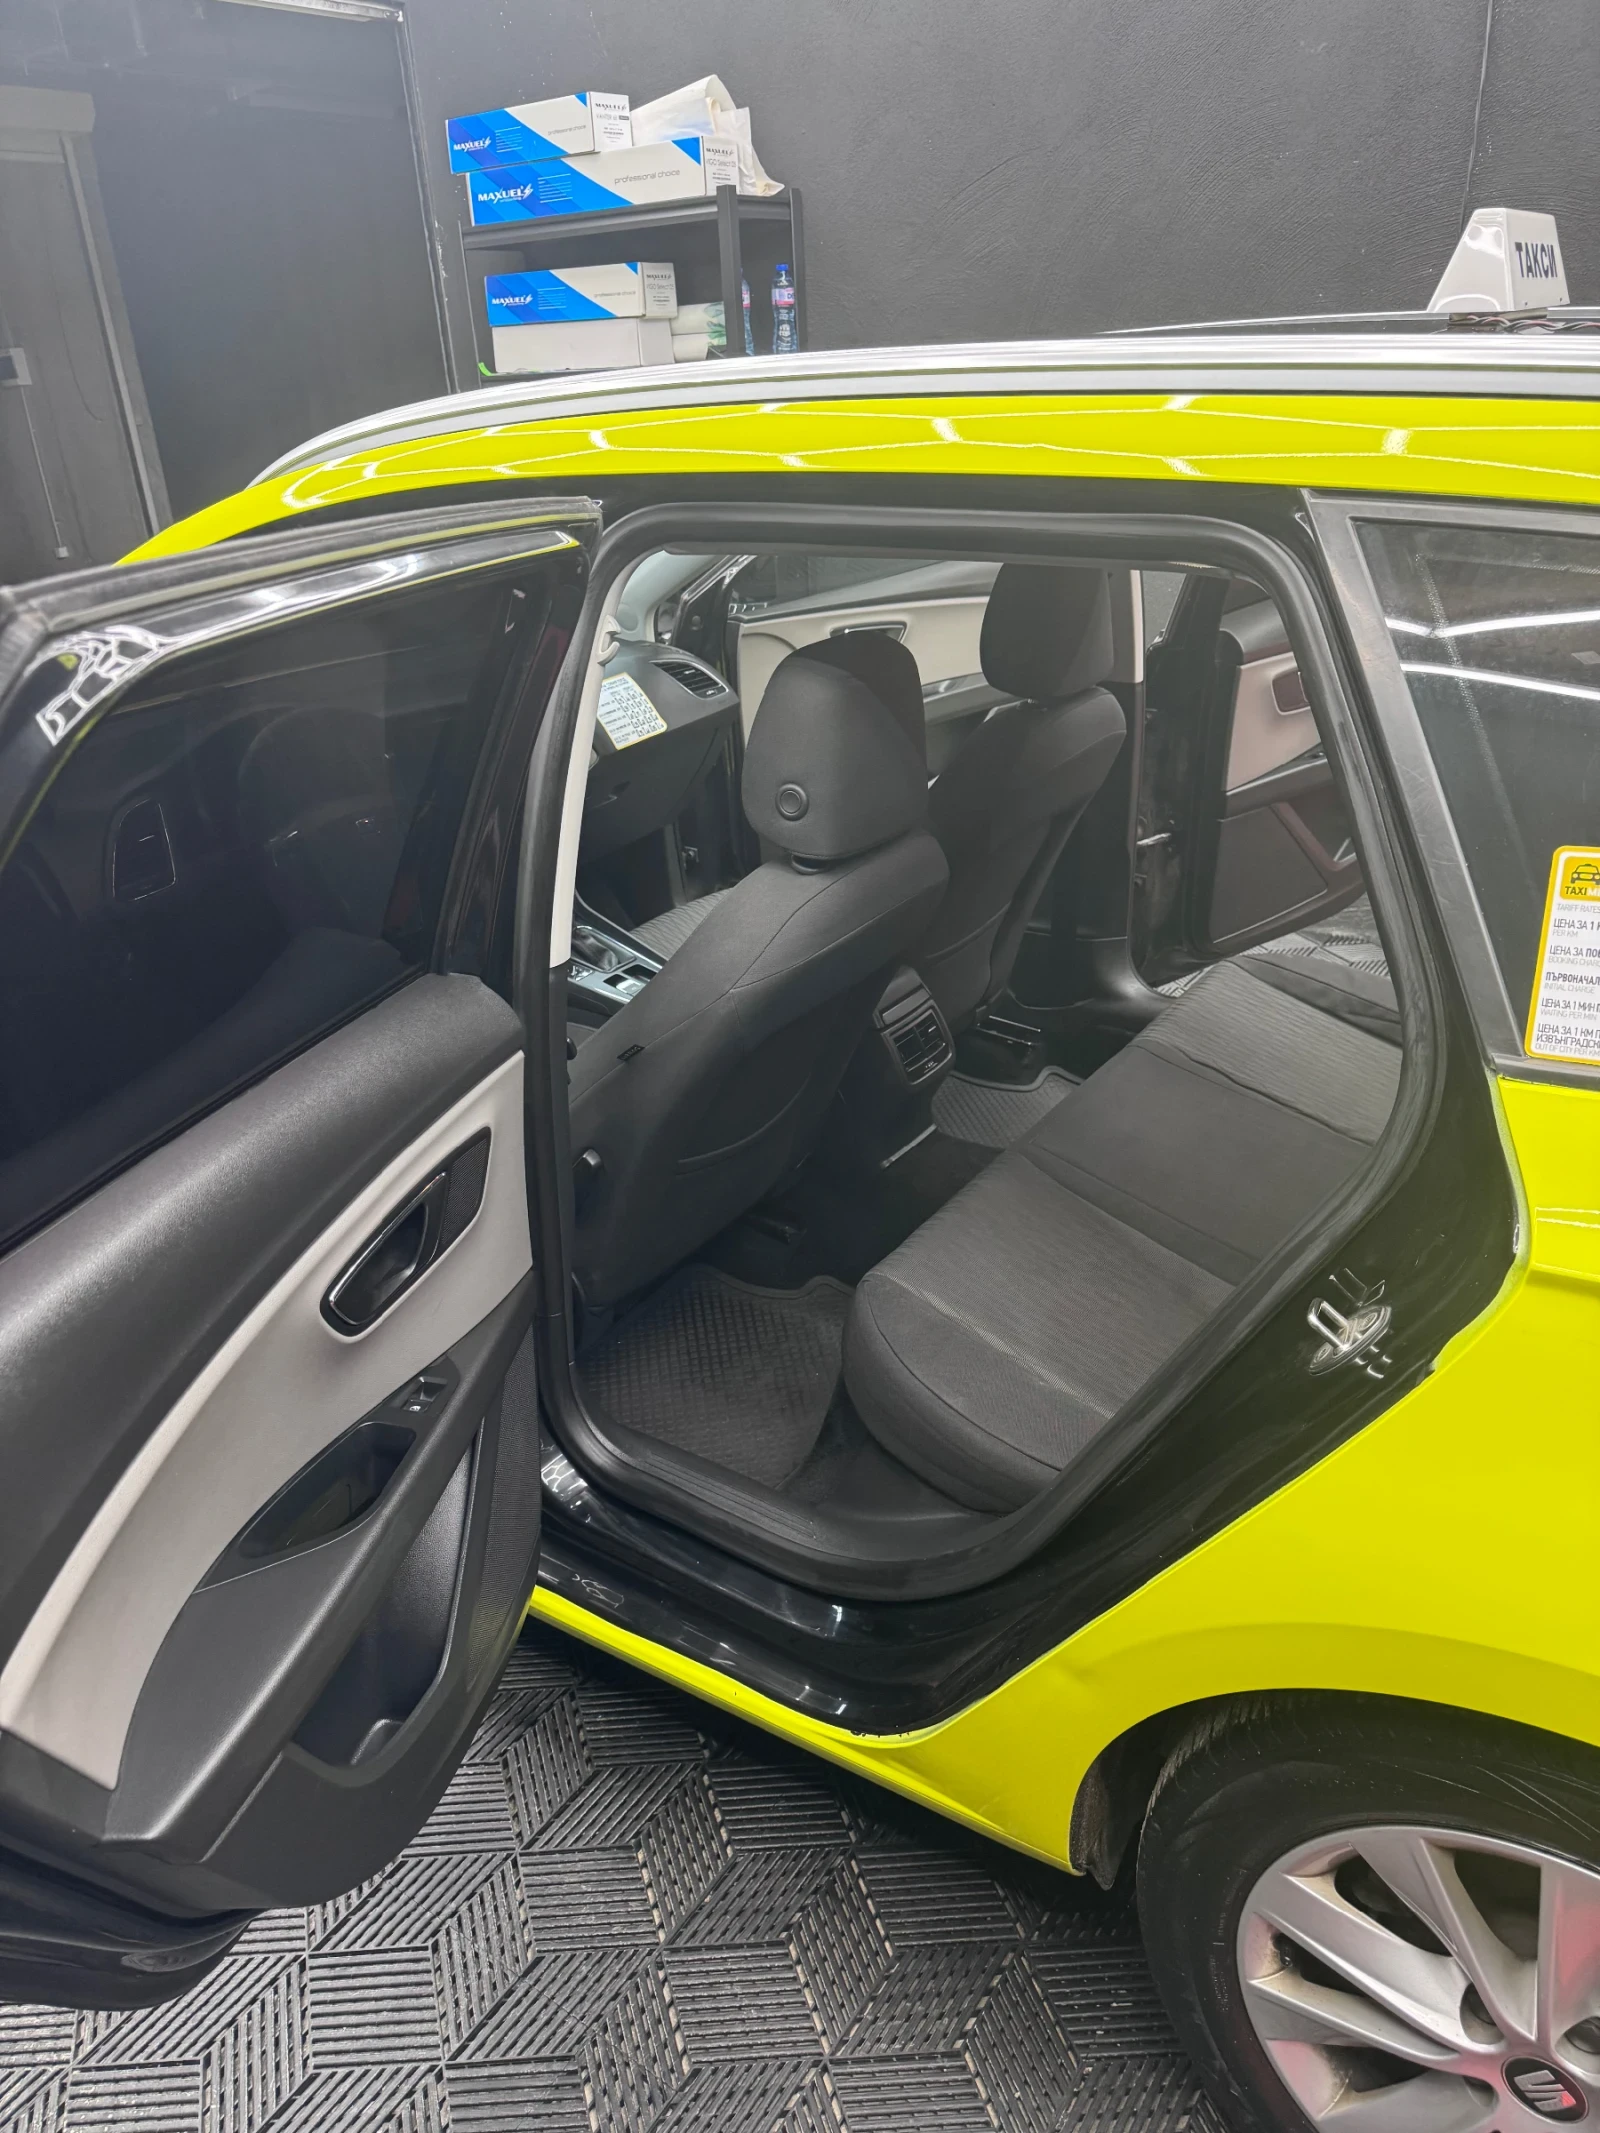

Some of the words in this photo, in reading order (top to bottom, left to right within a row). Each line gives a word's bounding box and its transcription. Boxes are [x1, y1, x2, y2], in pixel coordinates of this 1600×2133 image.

[614, 172, 656, 186] professional
[658, 169, 680, 178] choice
[1514, 242, 1557, 279] ТАКСИ
[1557, 903, 1579, 912] TARIFF
[1553, 918, 1575, 929] ЦЕНА
[1576, 920, 1588, 930] ЗА
[1590, 921, 1594, 931] 1
[1552, 929, 1566, 937] PER
[1567, 930, 1578, 938] KM
[1549, 945, 1571, 956] ЦЕНА
[1572, 947, 1584, 957] ЗА
[1548, 956, 1578, 965] BOOKING
[1568, 984, 1595, 994] CHARGE
[1541, 998, 1561, 1009] ЦЕНА
[1561, 1000, 1571, 1010] ЗА
[1569, 1010, 1582, 1020] PER
[1538, 1023, 1559, 1035] ЦЕНА
[1561, 1026, 1572, 1036] ЗА
[1580, 1028, 1594, 1039] КМ
[1535, 1043, 1549, 1051] OUT
